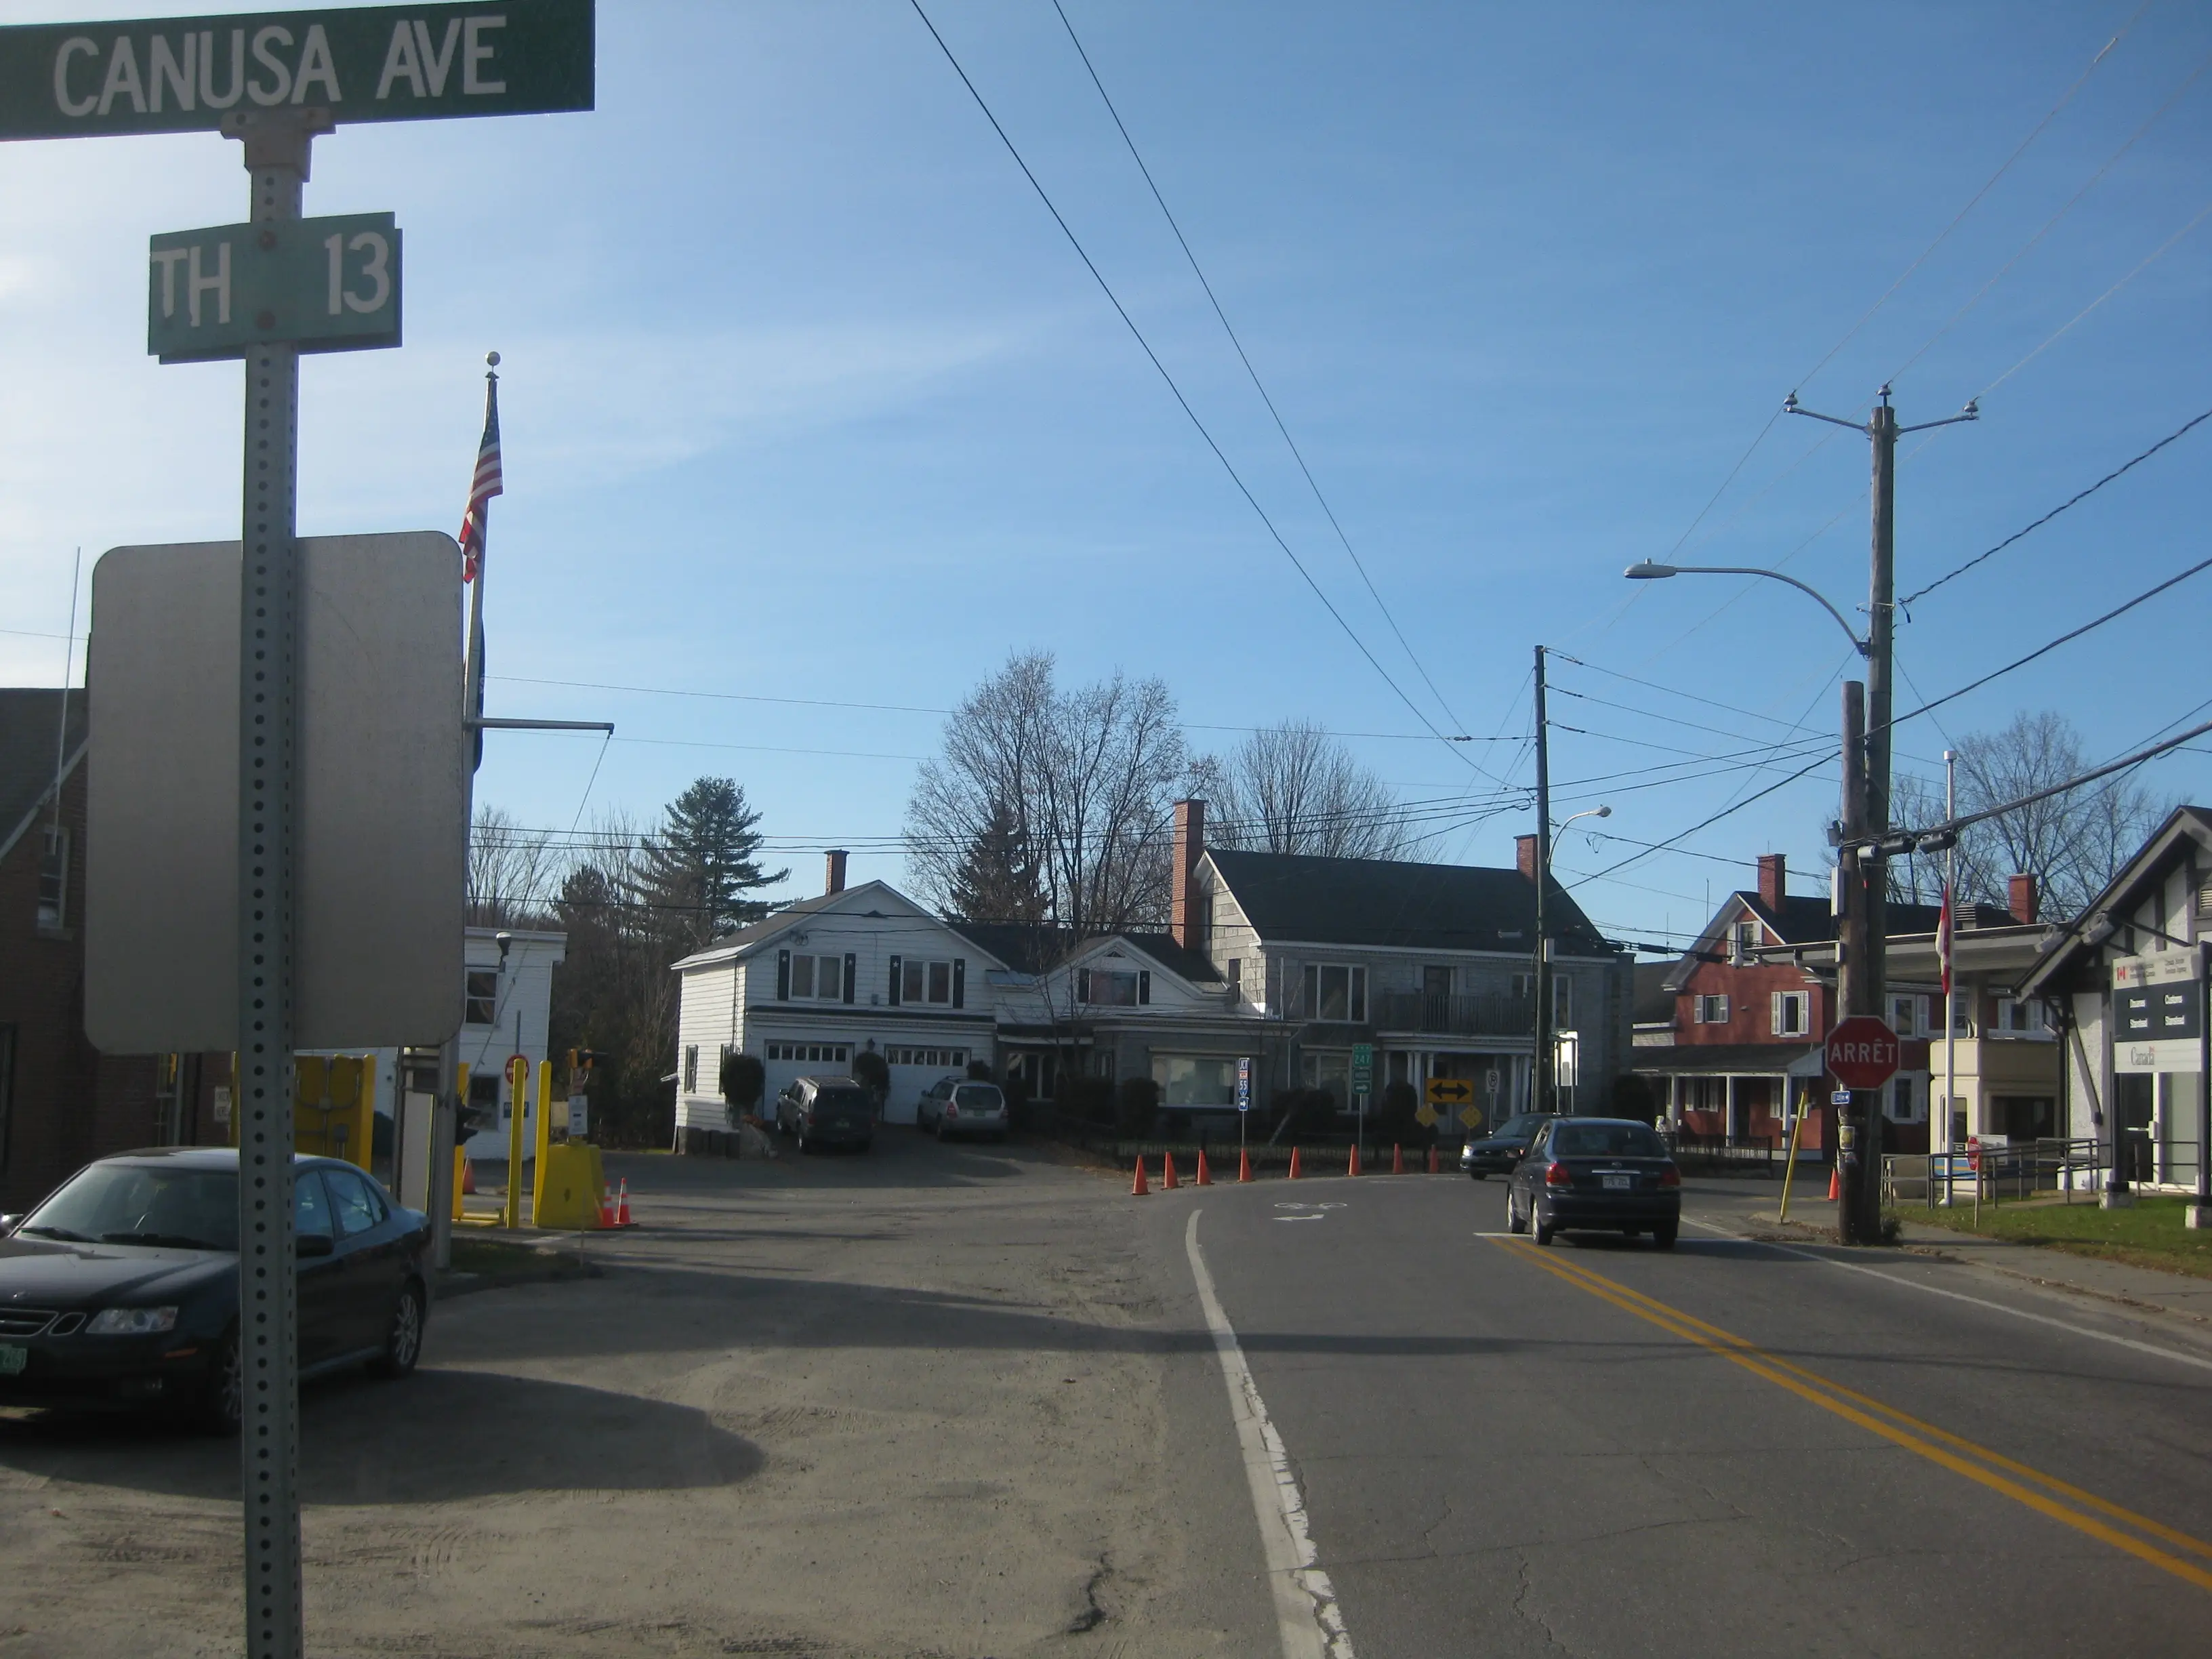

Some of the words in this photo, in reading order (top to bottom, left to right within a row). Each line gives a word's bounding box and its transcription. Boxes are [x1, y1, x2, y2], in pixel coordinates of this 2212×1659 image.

[55, 24, 342, 117] CANUSA
[376, 15, 507, 98] AVE
[150, 242, 231, 327] TH
[324, 231, 391, 316] 13
[1355, 1054, 1370, 1065] 247
[1830, 1038, 1896, 1063] ARRÊT
[1240, 1080, 1248, 1090] 55
